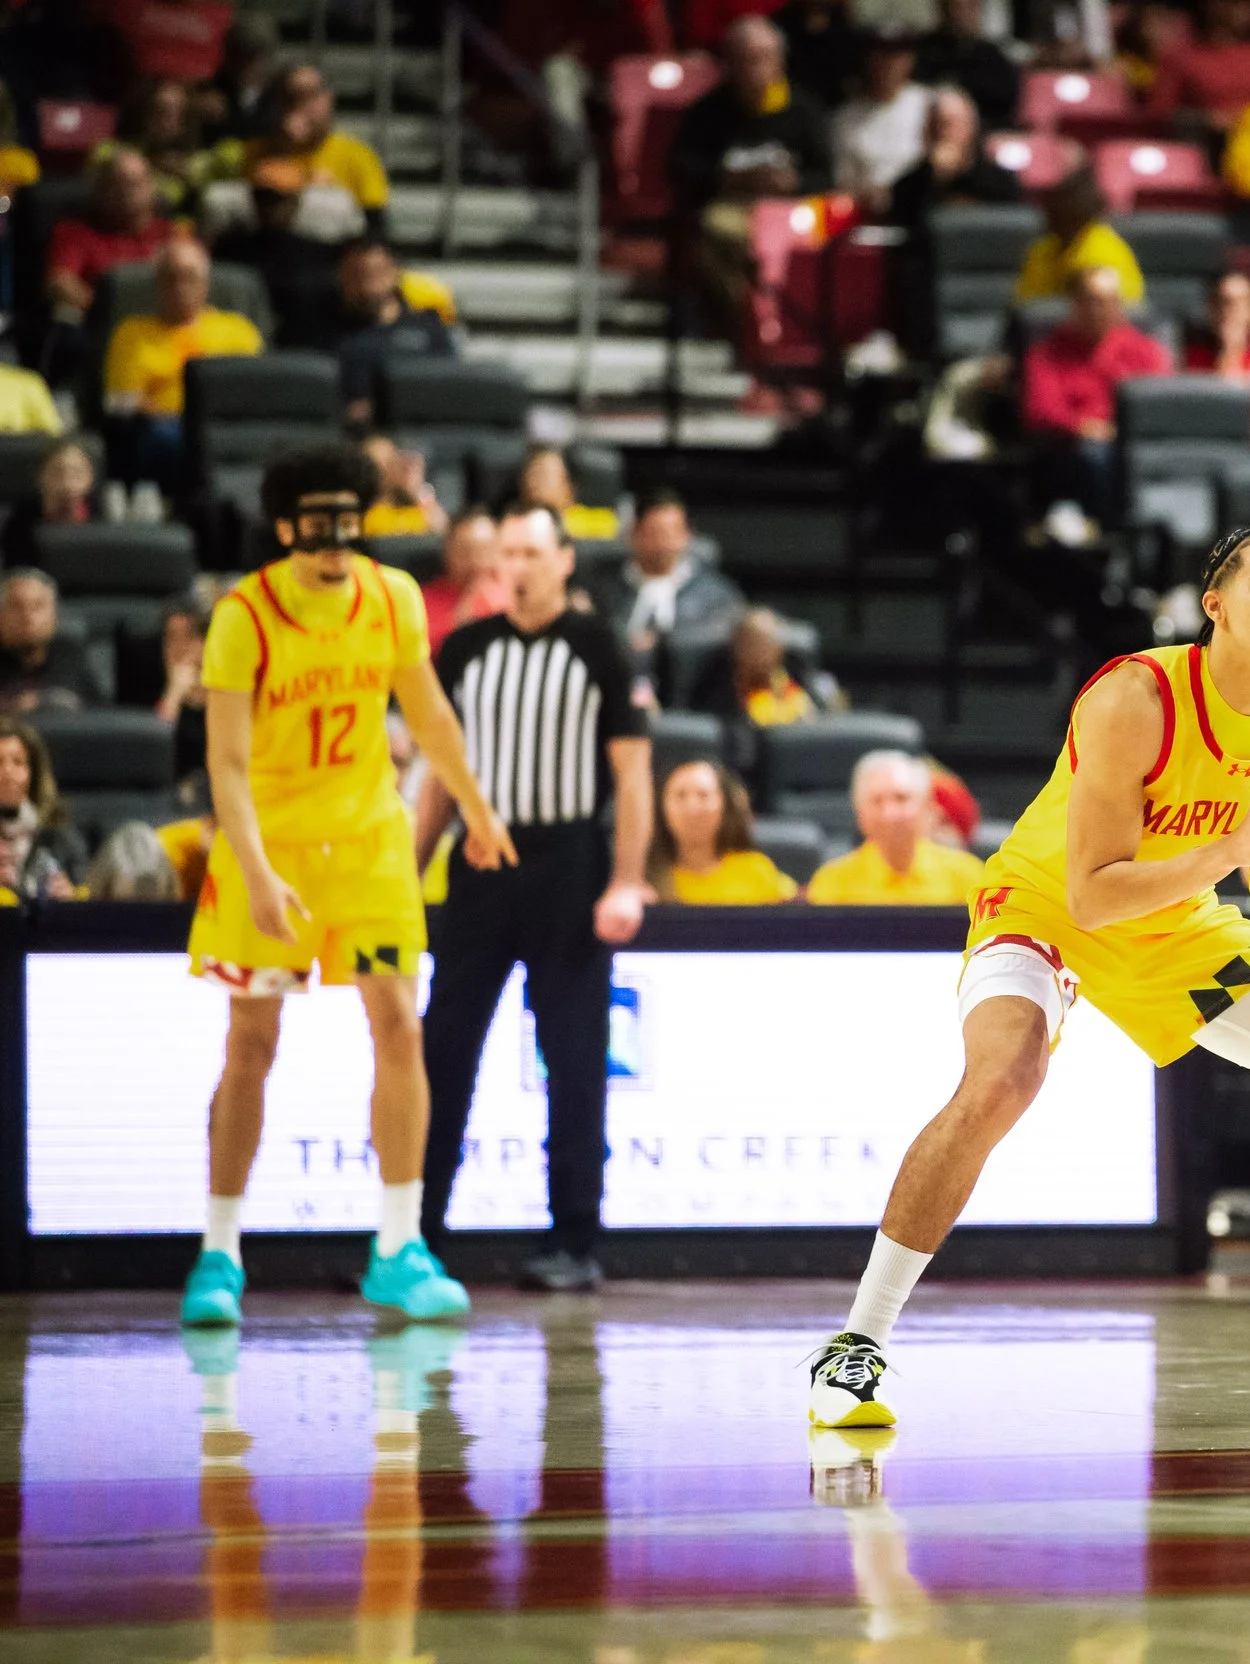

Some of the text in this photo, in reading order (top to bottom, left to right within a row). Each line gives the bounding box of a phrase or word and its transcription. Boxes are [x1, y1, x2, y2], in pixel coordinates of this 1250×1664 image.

[268, 665, 390, 711] MARYLAN
[309, 703, 356, 769] 12
[1143, 799, 1239, 836] MARYL
